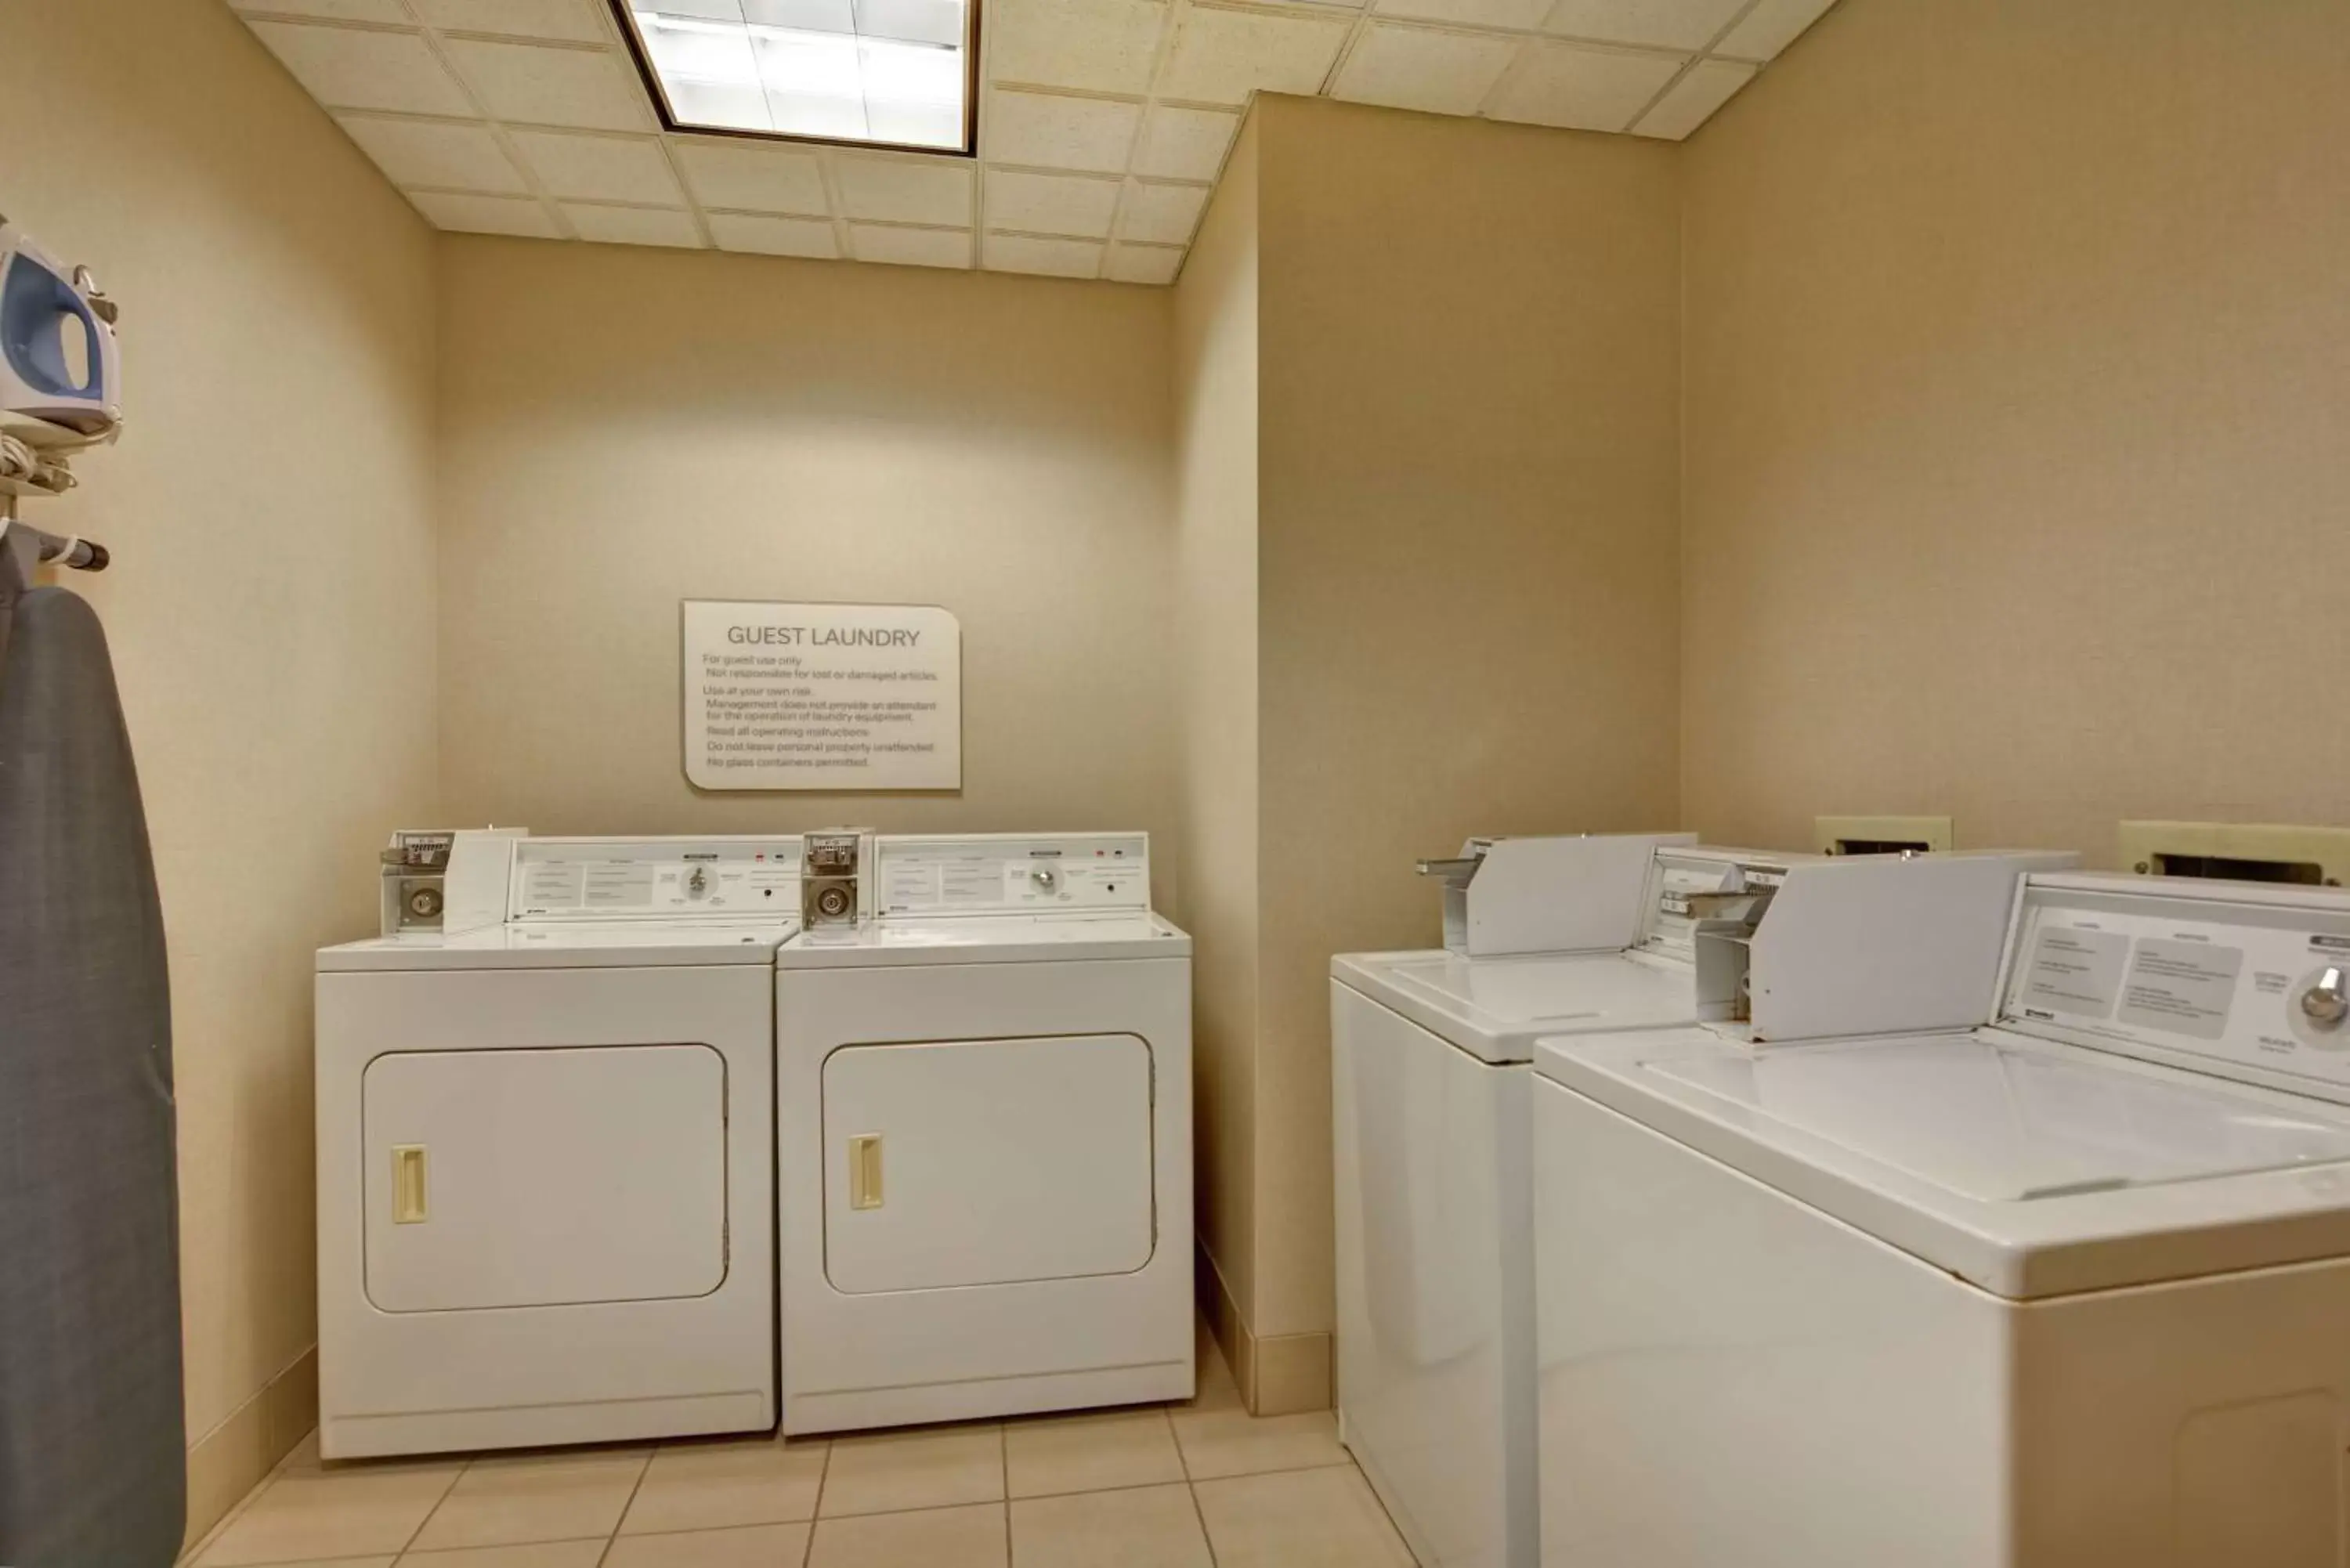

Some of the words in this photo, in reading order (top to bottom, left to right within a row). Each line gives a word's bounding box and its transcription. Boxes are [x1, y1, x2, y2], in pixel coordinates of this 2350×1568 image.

[728, 626, 806, 645] GUEST
[812, 627, 920, 646] LAUNDRY
[703, 654, 721, 664] For
[724, 655, 754, 667] guest
[707, 668, 726, 677] Not
[729, 669, 792, 679] responsible
[794, 670, 809, 678] for
[812, 670, 831, 679] lost
[848, 670, 897, 681] damaged
[703, 685, 725, 695] Use
[739, 688, 763, 697] your
[707, 699, 778, 710] Management
[781, 700, 807, 709] does
[829, 701, 869, 711] provide
[872, 702, 884, 710] an
[887, 702, 936, 710] attendant
[707, 710, 721, 720] for
[725, 710, 742, 720] the
[744, 711, 797, 721] operation
[799, 711, 810, 720] of
[812, 712, 851, 723] laundry
[707, 727, 735, 735] Read
[737, 727, 750, 735] all
[752, 727, 803, 738] operating
[707, 742, 723, 751] Do
[725, 742, 743, 751] not
[747, 742, 775, 751] leave
[777, 742, 822, 752] personal
[825, 742, 871, 754] property
[707, 758, 723, 767] No
[726, 758, 754, 768] glass
[756, 758, 812, 768] containers
